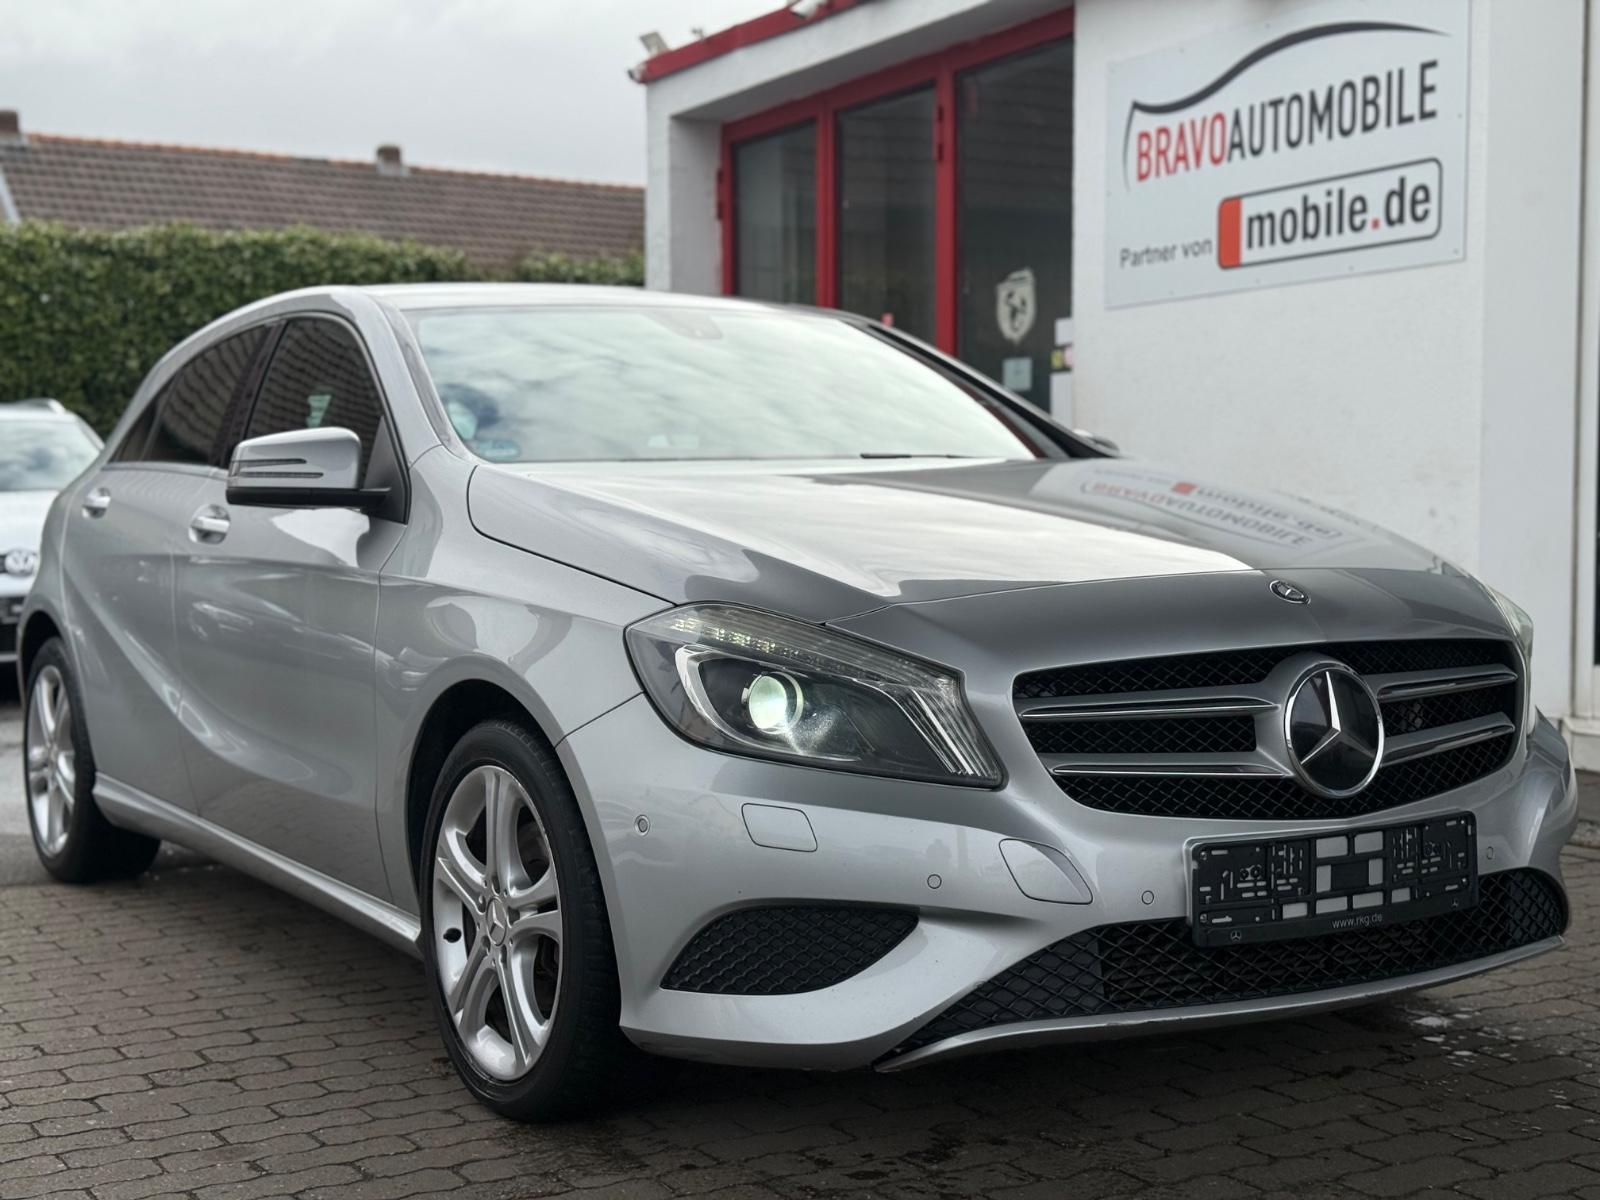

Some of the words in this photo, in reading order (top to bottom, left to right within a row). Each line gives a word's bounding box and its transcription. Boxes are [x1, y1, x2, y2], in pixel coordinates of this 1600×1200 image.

[1137, 60, 1438, 182] BRAVOAUTOMOBILE
[1247, 177, 1431, 250] mobile.de
[1120, 246, 1177, 269] Partner
[1181, 239, 1212, 258] von
[1331, 912, 1383, 929] www.rkg.de
